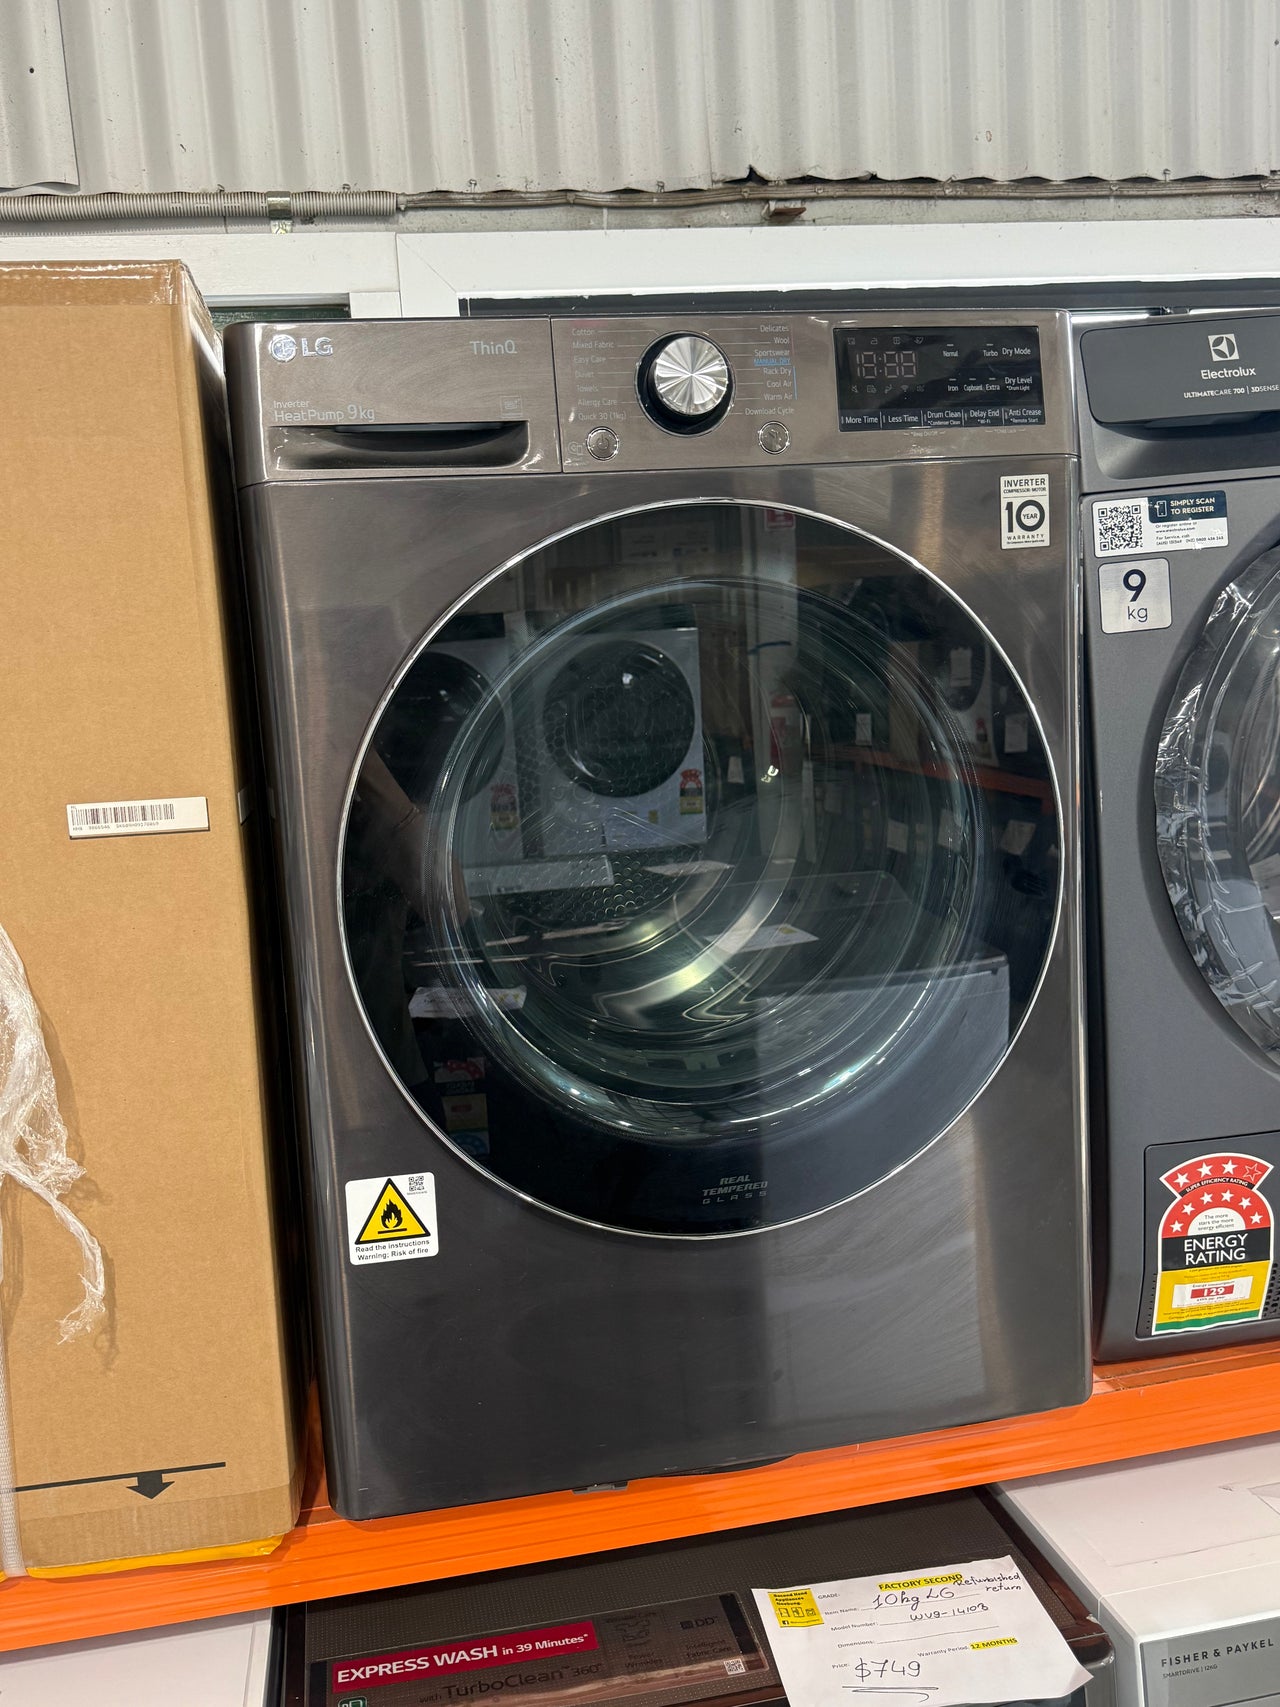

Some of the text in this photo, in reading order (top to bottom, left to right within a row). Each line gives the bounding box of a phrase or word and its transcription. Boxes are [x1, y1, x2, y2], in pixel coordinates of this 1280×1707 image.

[760, 323, 790, 333] Delicates
[774, 336, 790, 345] Wool
[302, 337, 334, 357] LG
[469, 339, 517, 357] ThinQ
[1002, 347, 1031, 357] Dry Mode
[754, 349, 790, 359] Sportswear
[983, 349, 999, 357] Turbo
[763, 366, 792, 376] Rack Dry
[1200, 366, 1256, 380] Electrolux
[766, 380, 792, 388] Cool Air
[1004, 376, 1033, 386] Dry Level
[947, 384, 959, 392] Iron
[985, 383, 1000, 391] Extra
[1183, 384, 1280, 399] ULTIMATECARE 700 3DSENSE
[763, 392, 793, 401] Warm Air
[273, 400, 309, 408] Inverter
[745, 407, 795, 417] Download Cycle
[927, 410, 961, 419] Drum Clean
[969, 409, 1000, 419] Delay End
[1008, 408, 1042, 416] Anti Crease
[845, 415, 879, 424] More Time
[888, 414, 919, 423] Less Time
[1003, 477, 1046, 488] INVERTER
[1170, 497, 1216, 507] SIMPLY SCAN
[1182, 505, 1215, 514] REGISTER
[1005, 499, 1045, 533] 10
[1007, 533, 1044, 541] WARRANTY
[1122, 568, 1147, 603] 9
[1127, 605, 1148, 623] kg
[720, 1174, 751, 1185] REAL
[702, 1181, 769, 1196] TEMPERED
[1185, 1177, 1248, 1193] SUPER EFFICIENCY RATING
[702, 1190, 768, 1205] GLASS
[355, 1245, 374, 1253] Read
[388, 1239, 430, 1249] instructions
[1184, 1233, 1249, 1252] ENERGY
[1185, 1247, 1246, 1266] RATING
[1203, 1287, 1225, 1297] 129
[879, 1573, 963, 1591] FACTORY SECOND
[953, 1573, 1021, 1587] Refurbished
[985, 1584, 1022, 1592] return
[873, 1587, 955, 1611] 10kg LG
[851, 1621, 879, 1629] Number:
[837, 1640, 874, 1649] Dimensions:
[917, 1648, 947, 1657] Warranty
[947, 1644, 969, 1652] Period:
[981, 1637, 1018, 1648] MONTHS
[1161, 1638, 1274, 1668] FISHER & PAYKEL
[337, 1656, 430, 1684] EXPRESS
[433, 1644, 498, 1667] WASH
[502, 1647, 513, 1656] in
[516, 1643, 533, 1653] 39
[854, 1657, 921, 1683] $749
[1162, 1663, 1218, 1680] SMARTDRIVE 12KG
